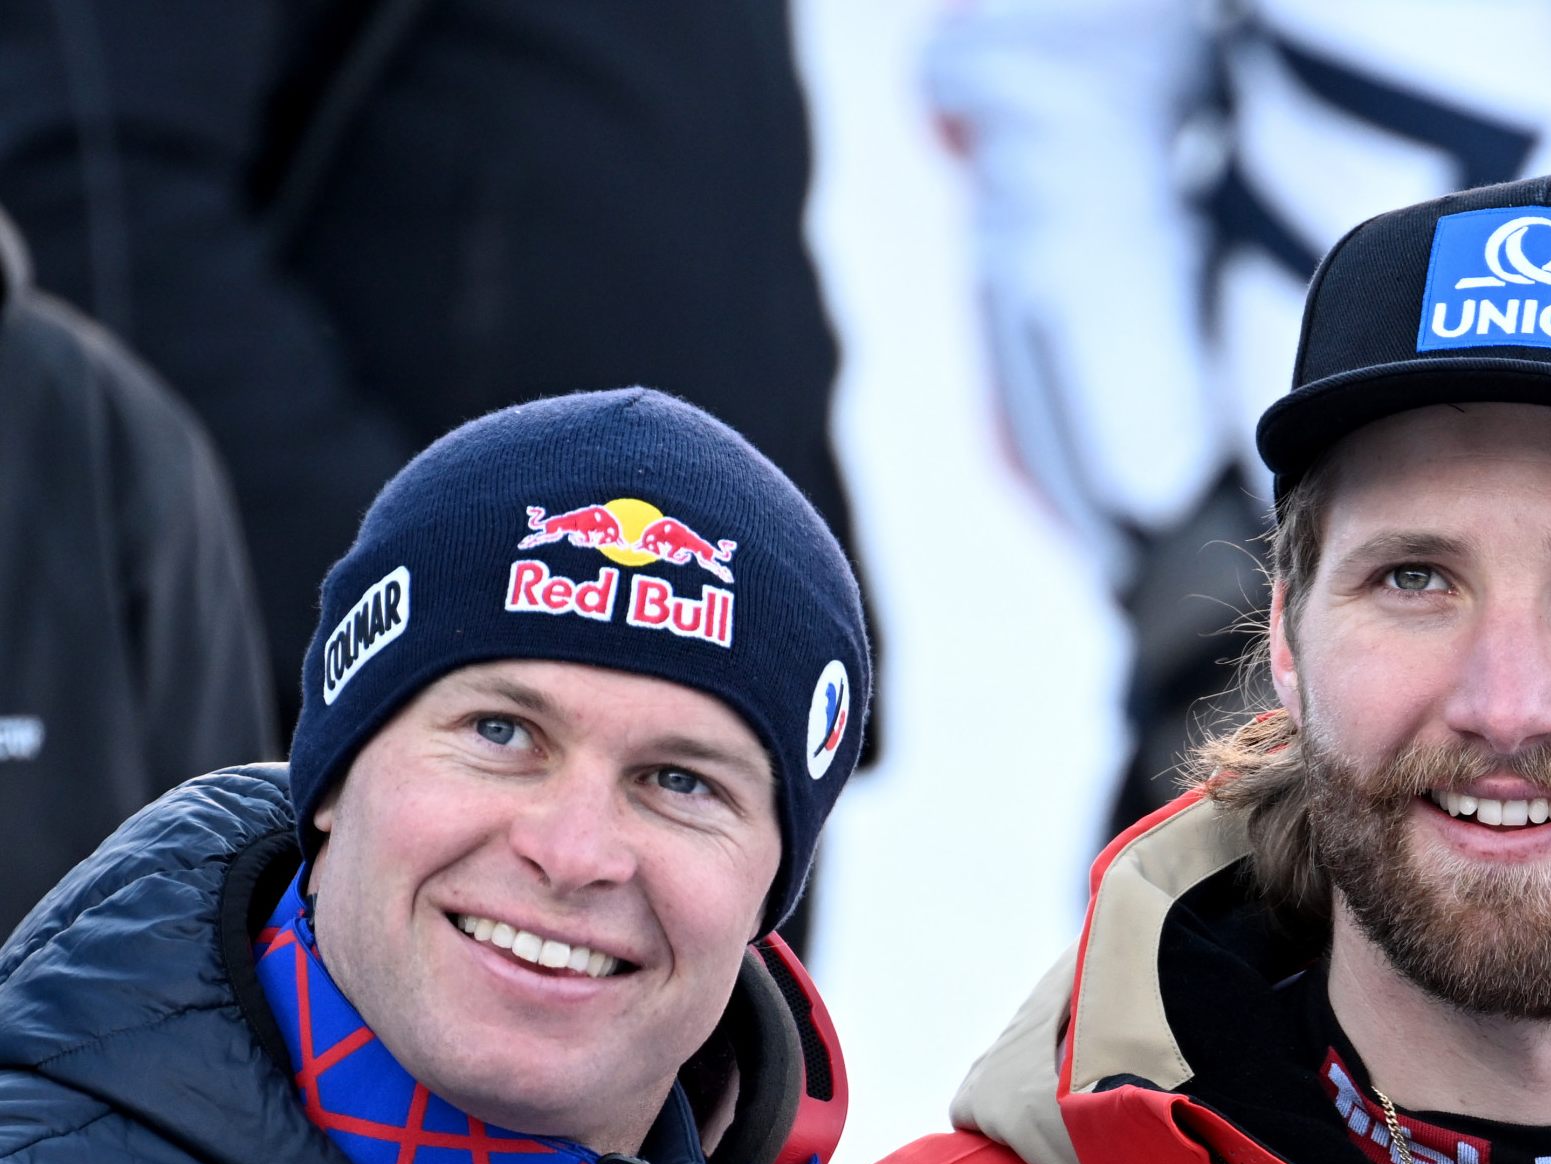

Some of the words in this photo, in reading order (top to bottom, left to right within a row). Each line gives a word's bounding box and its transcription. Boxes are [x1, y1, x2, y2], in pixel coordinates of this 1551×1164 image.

[326, 580, 401, 691] COLMAR
[508, 561, 618, 620] Red
[629, 577, 732, 646] Bull
